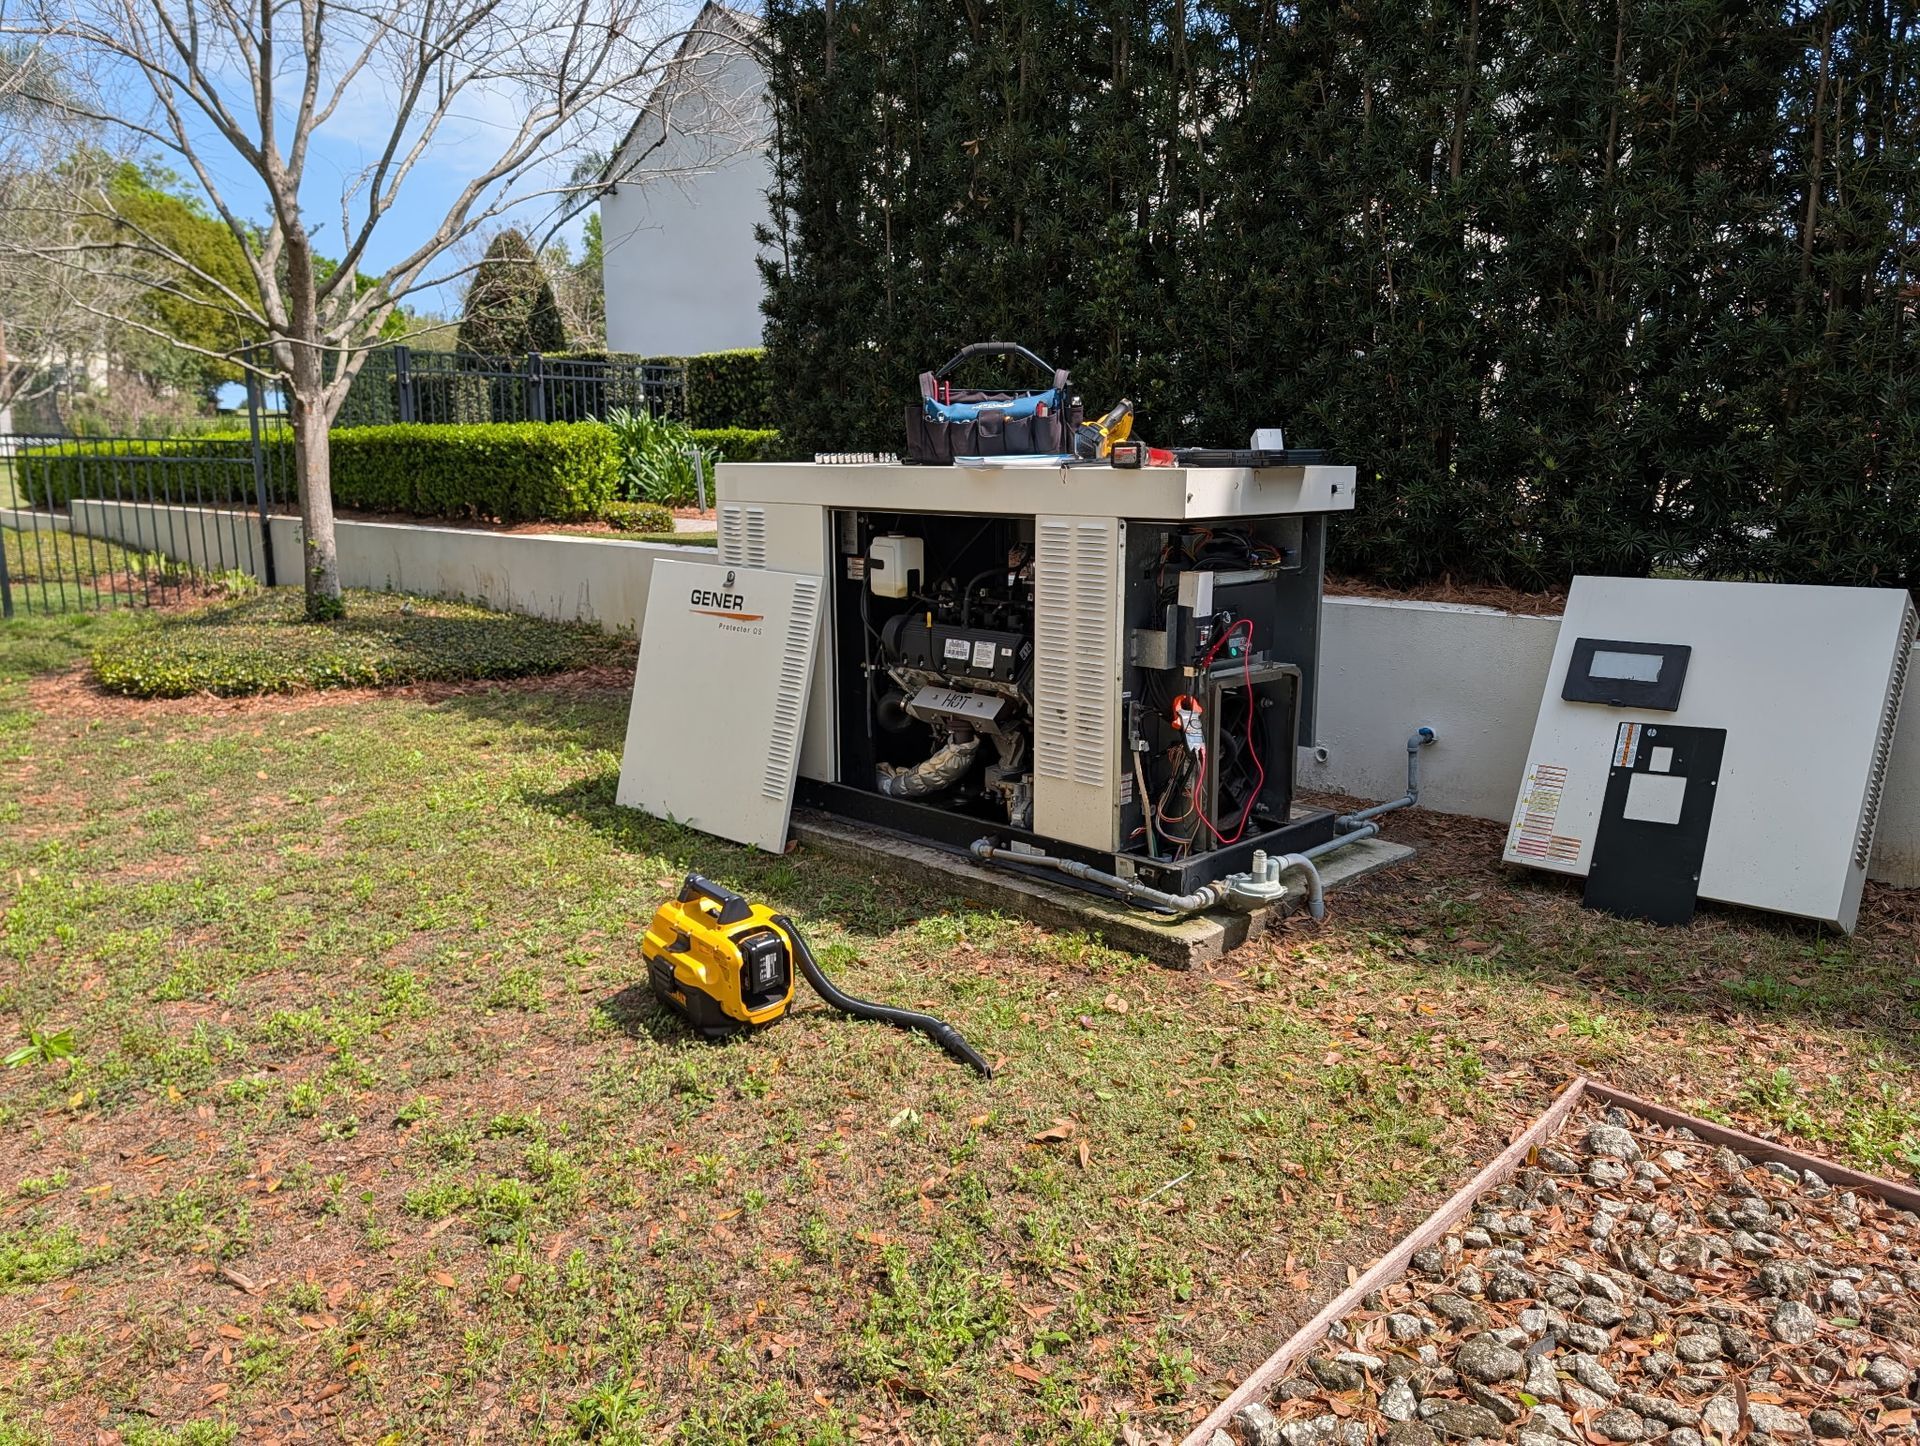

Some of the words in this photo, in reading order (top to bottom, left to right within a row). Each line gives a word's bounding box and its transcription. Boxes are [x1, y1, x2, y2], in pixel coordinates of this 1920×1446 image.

[691, 589, 744, 611] GENER
[719, 622, 750, 633] Protector
[941, 693, 971, 709] HOT
